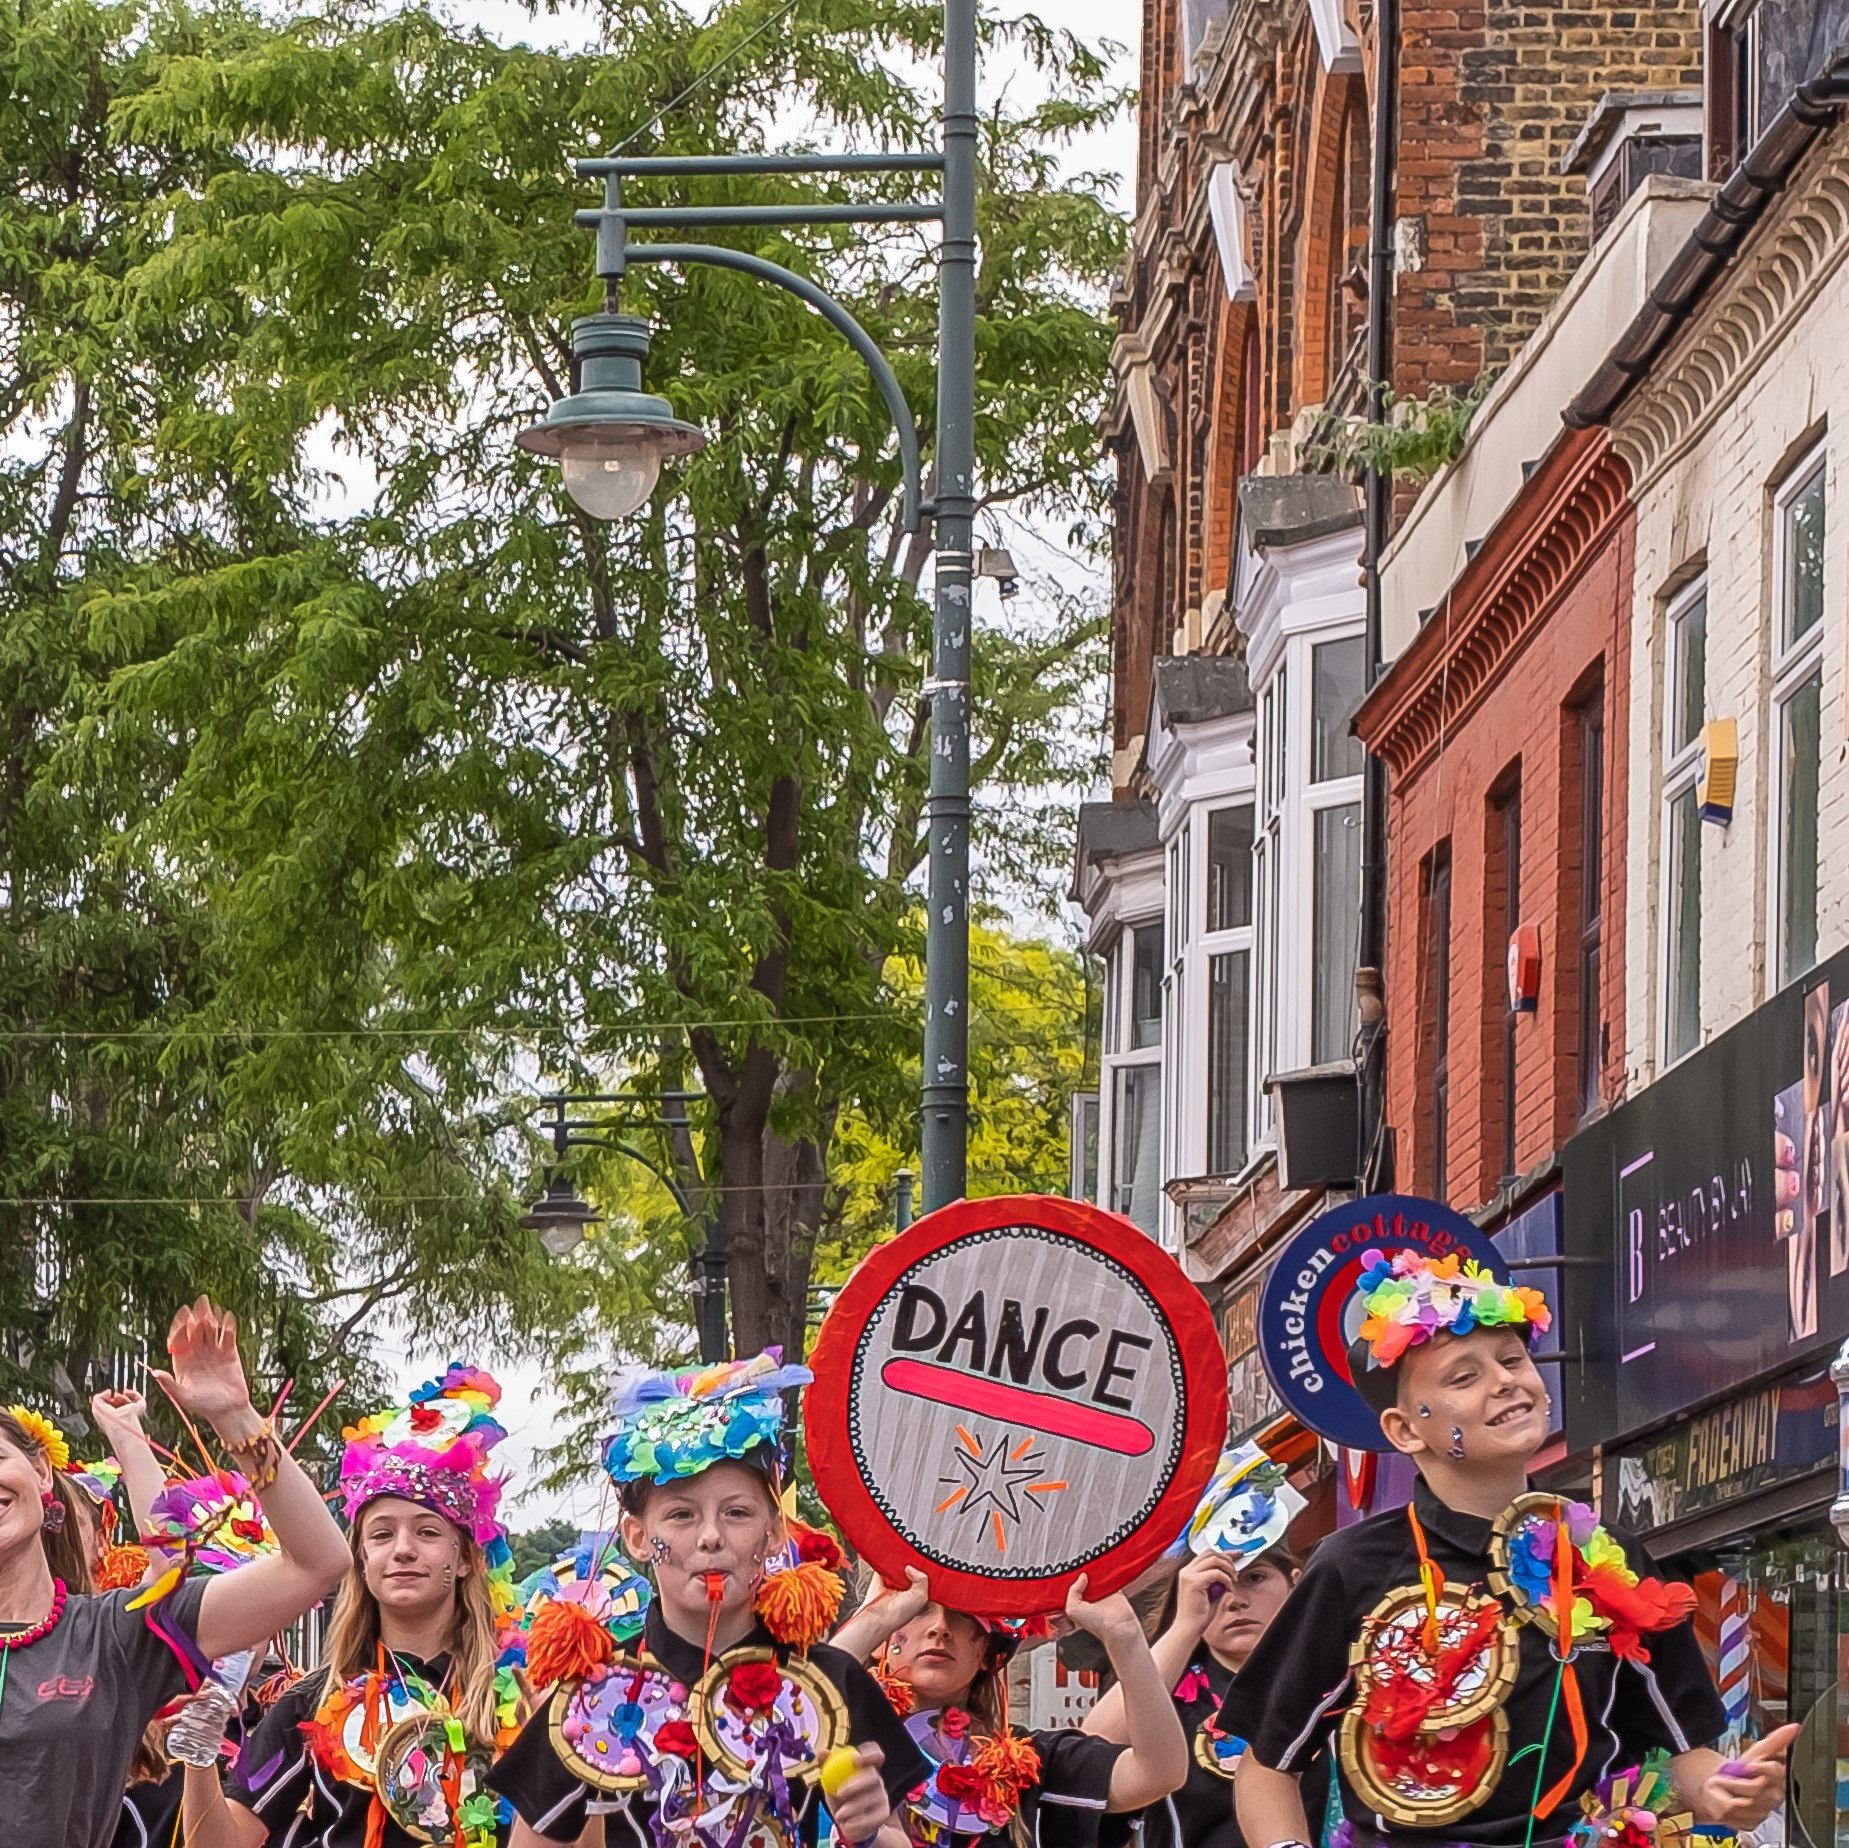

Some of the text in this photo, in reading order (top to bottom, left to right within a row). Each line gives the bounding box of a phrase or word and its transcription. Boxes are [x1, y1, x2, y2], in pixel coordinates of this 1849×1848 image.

[1628, 1207, 1643, 1304] B
[891, 1283, 1153, 1412] DANCE
[1279, 1247, 1336, 1393] chicken
[1686, 1385, 1781, 1492] FADEAWAY
